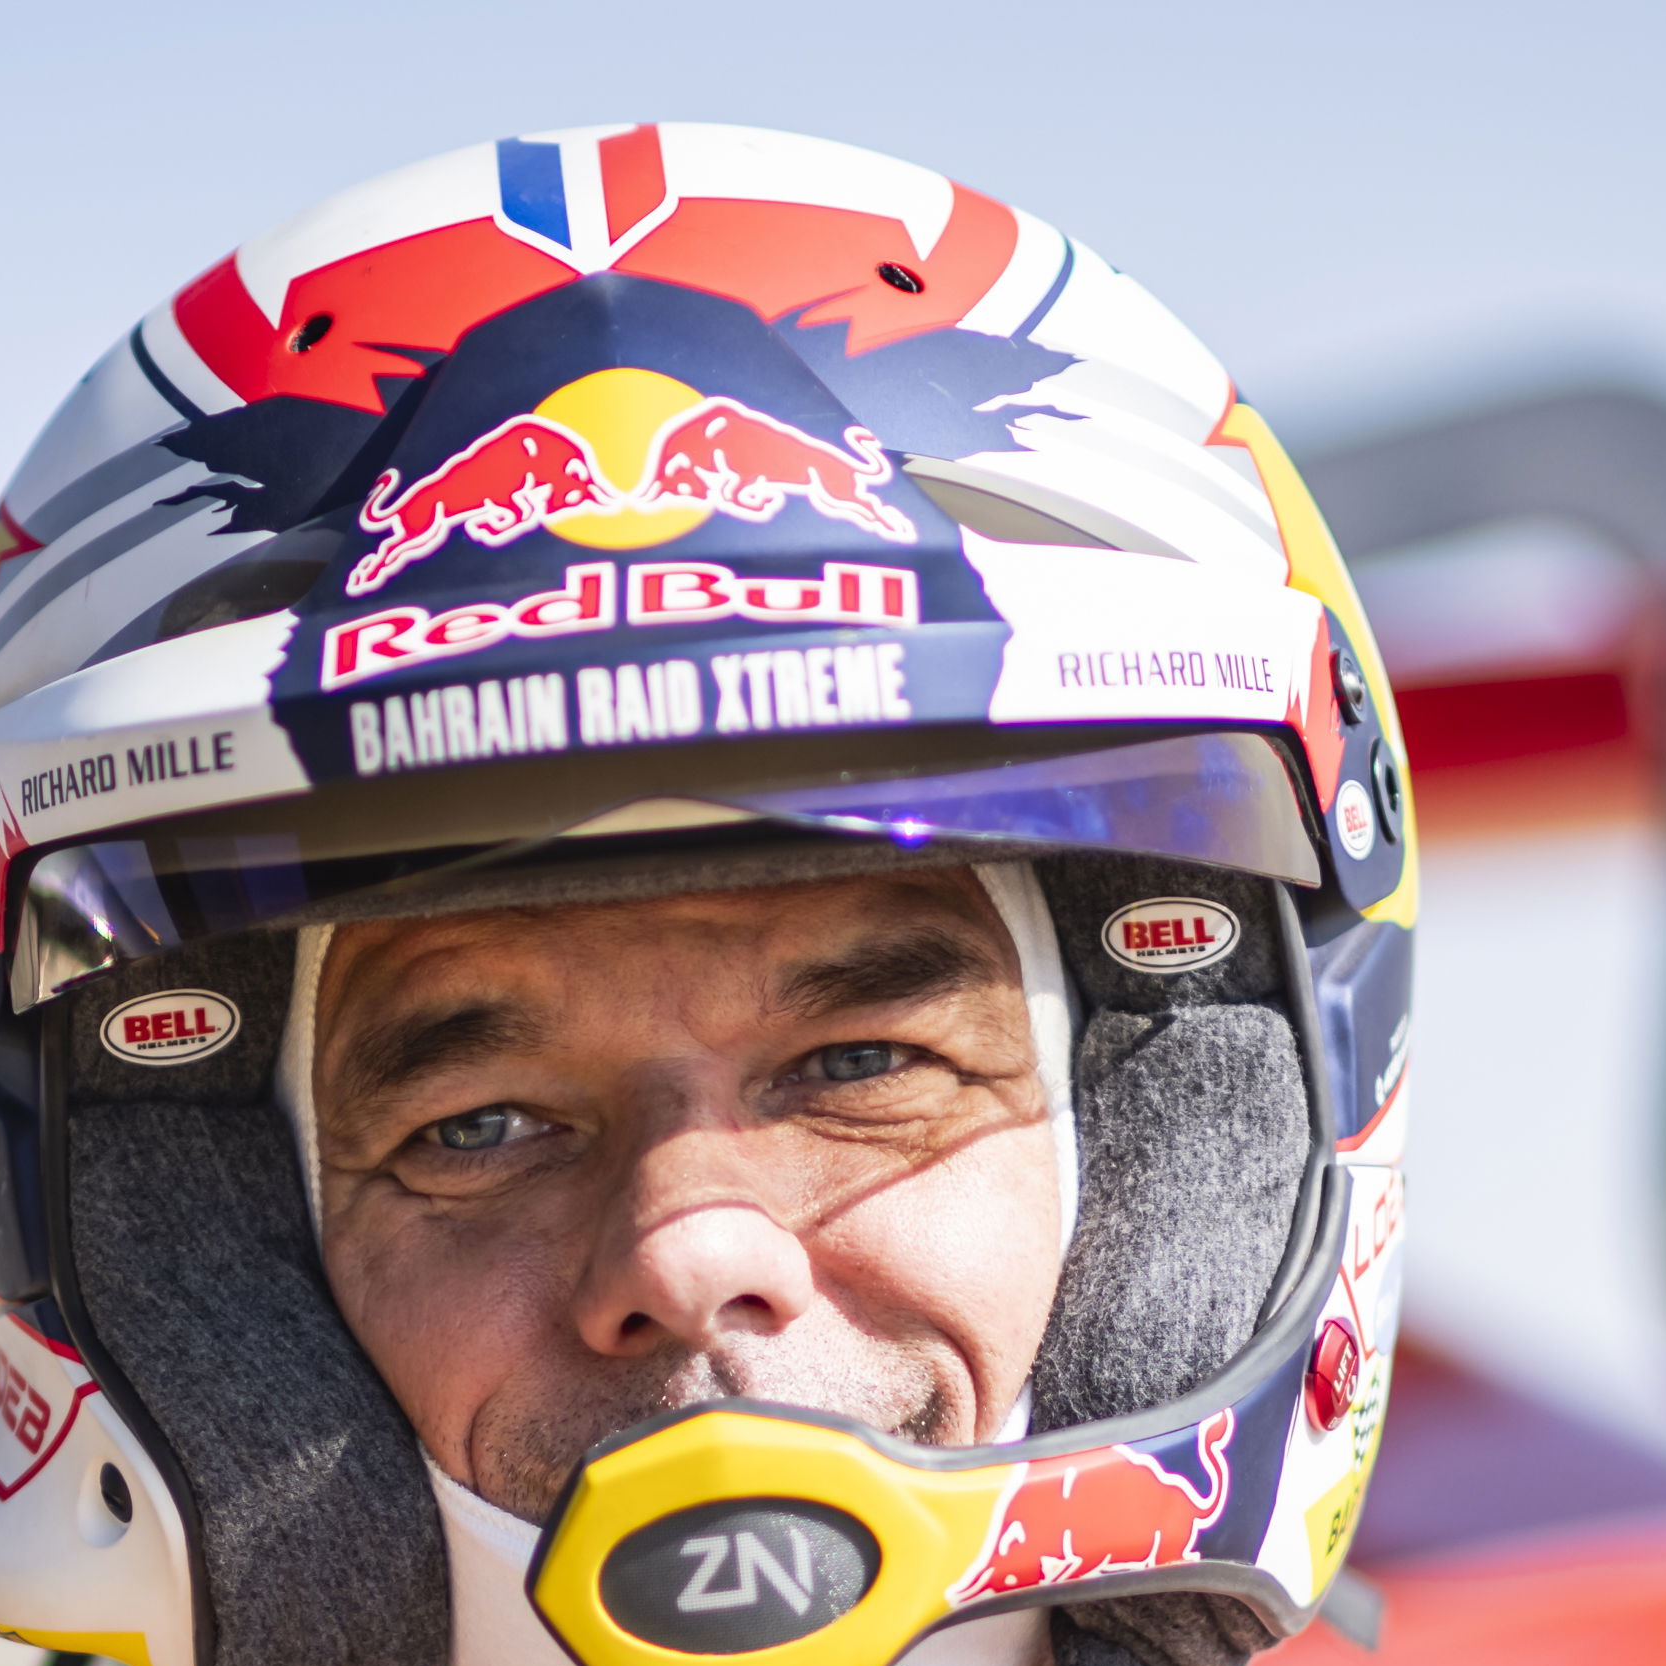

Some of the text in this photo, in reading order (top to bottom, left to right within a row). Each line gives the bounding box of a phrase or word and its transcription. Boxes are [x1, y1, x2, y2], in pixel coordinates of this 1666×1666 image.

[321, 561, 919, 692] Red Bull
[1058, 650, 1275, 695] RICHARD MILLE
[350, 642, 912, 777] BAHRAIN RAID XTREME
[21, 731, 235, 818] RICHARD MILLE
[1343, 804, 1368, 833] BELL
[1122, 916, 1216, 950] BELL
[1136, 945, 1206, 957] HELMETS
[123, 1007, 216, 1044] BELL
[137, 1036, 207, 1050] HELMETS
[1333, 1341, 1354, 1394] LIFT
[675, 1528, 815, 1619] ZN
